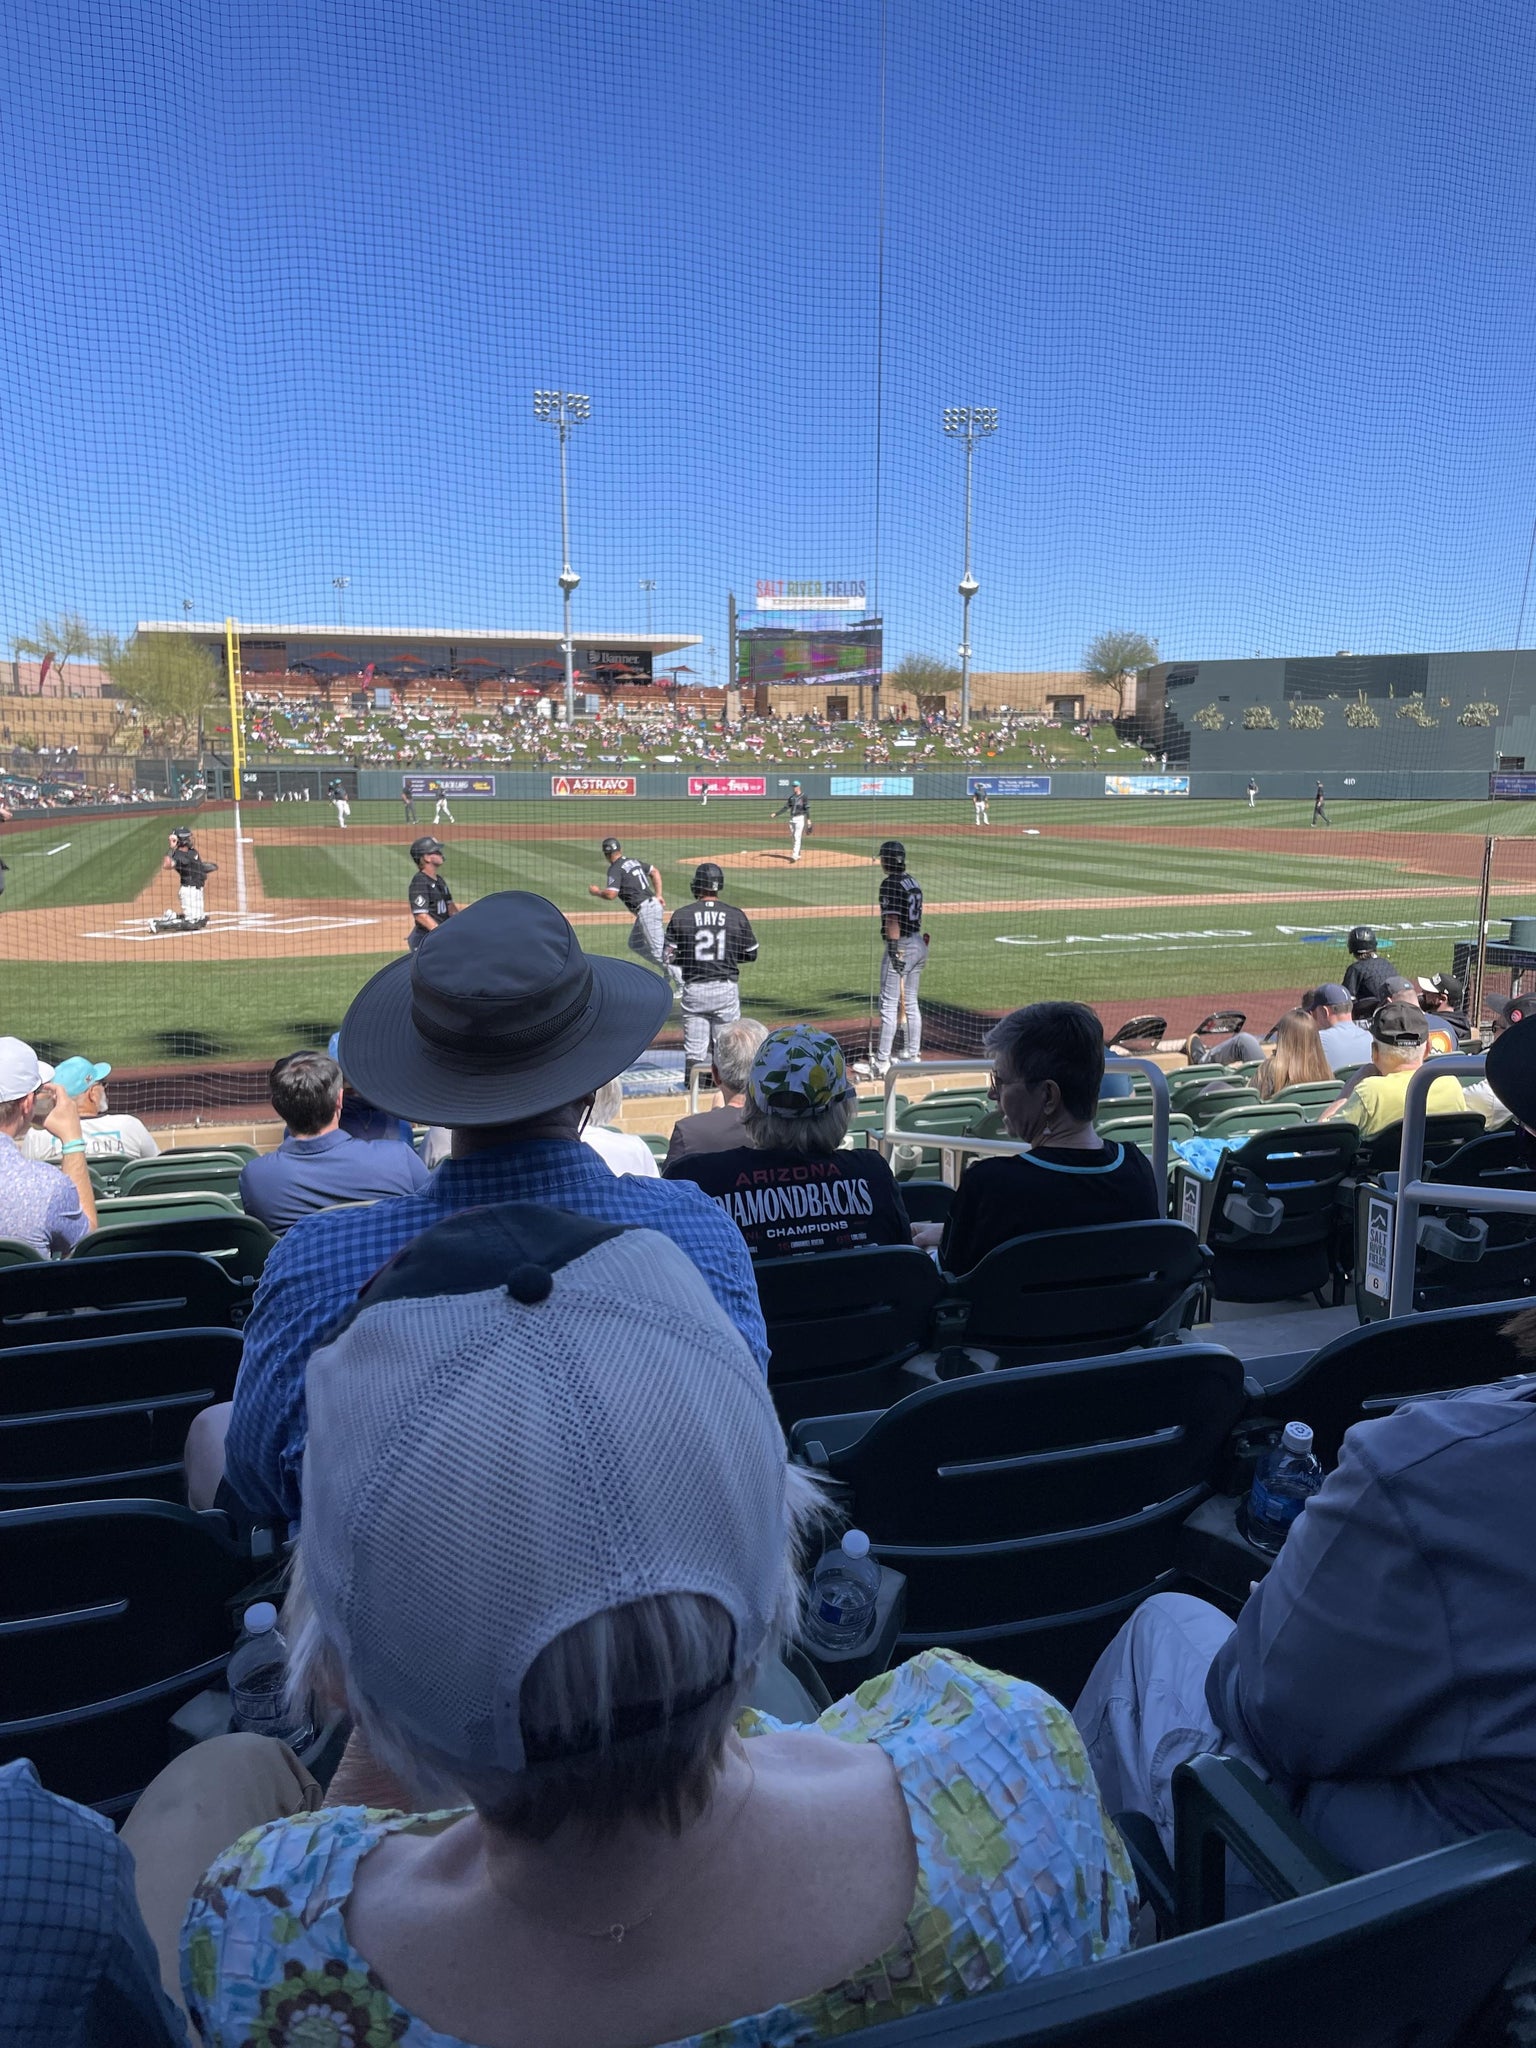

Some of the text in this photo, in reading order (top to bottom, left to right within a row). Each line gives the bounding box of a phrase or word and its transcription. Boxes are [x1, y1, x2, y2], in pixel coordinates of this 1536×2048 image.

[756, 580, 865, 598] SALT RIVER FIELDS
[602, 652, 640, 664] Banner
[573, 779, 628, 789] ASTRAVO
[1343, 777, 1356, 785] 410
[694, 911, 726, 927] RAYS
[695, 929, 727, 961] 21
[736, 1163, 842, 1187] ARIZONA
[766, 1220, 849, 1239] CHAMPIONS
[1369, 1228, 1386, 1246] SALT
